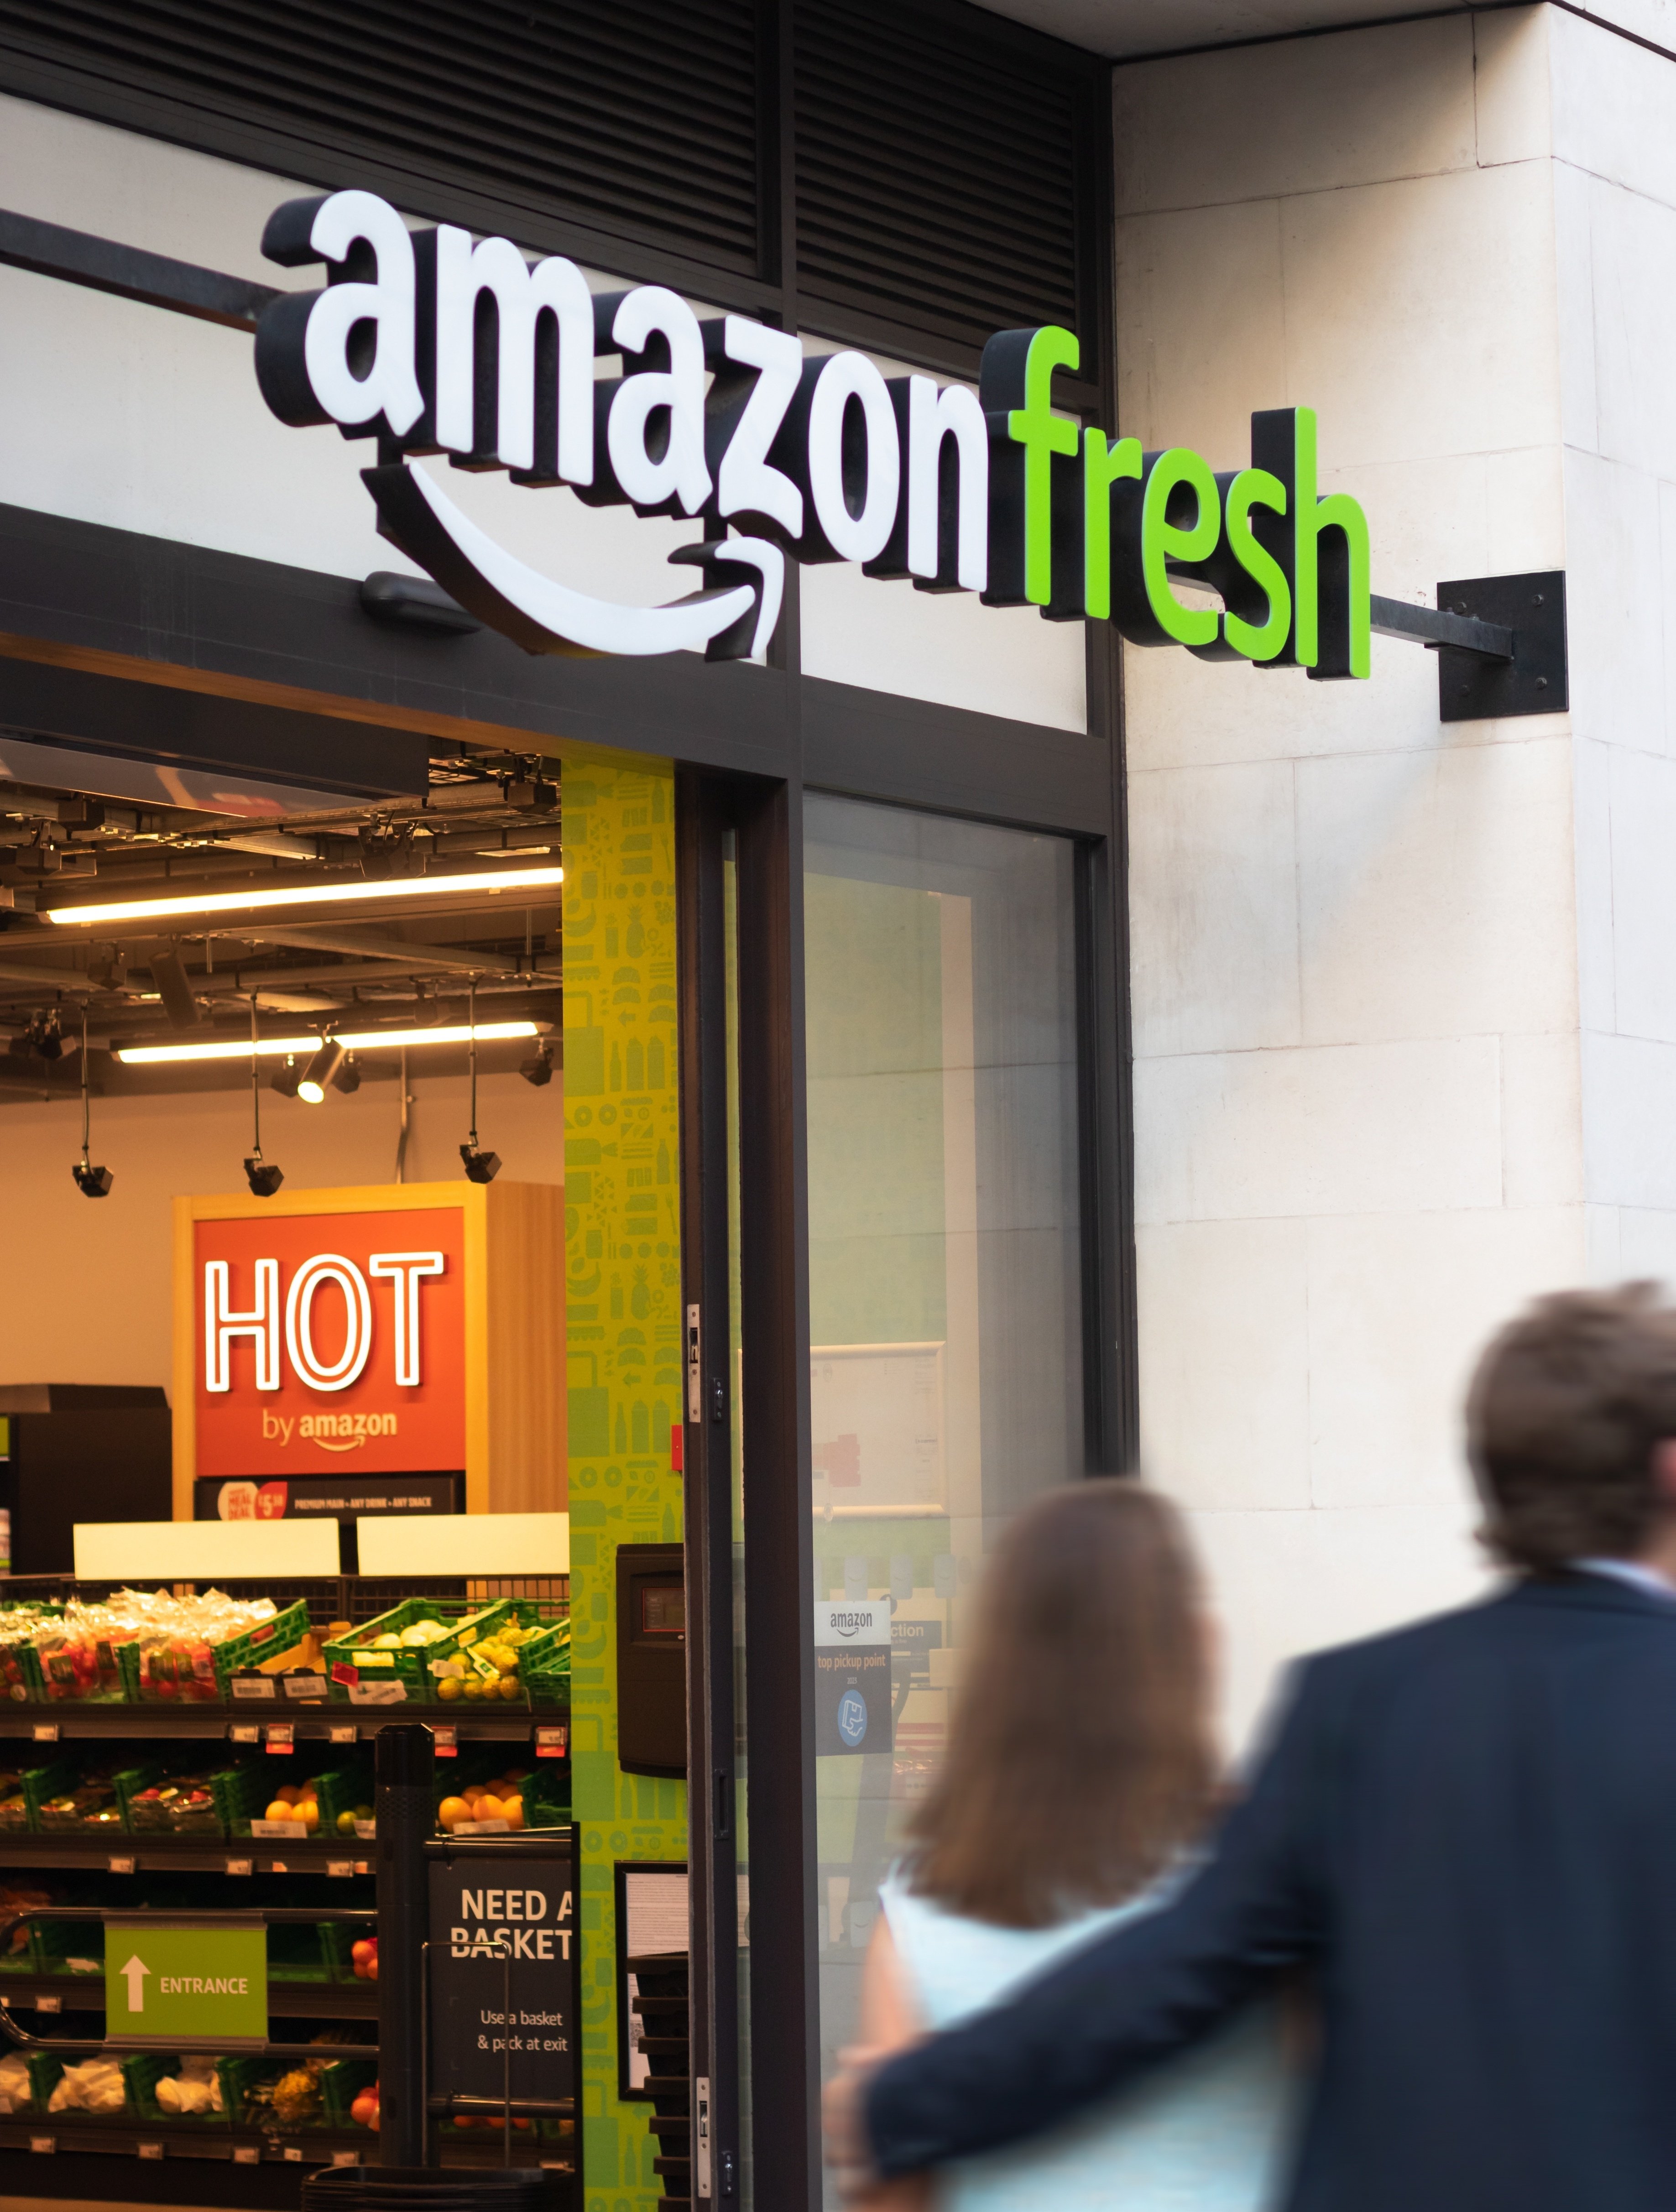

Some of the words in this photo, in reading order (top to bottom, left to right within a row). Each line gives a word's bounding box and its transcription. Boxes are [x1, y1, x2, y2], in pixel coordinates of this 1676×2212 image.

[305, 189, 989, 593] amazon
[1008, 326, 1370, 680] fresh
[205, 1251, 444, 1393] HOT
[262, 1408, 295, 1447] by
[299, 1413, 397, 1438] amazon
[830, 1612, 872, 1628] amazon
[818, 1656, 832, 1671] top
[834, 1654, 861, 1670] pickup
[864, 1653, 886, 1670] point
[462, 1890, 547, 1920] NEED
[451, 1928, 572, 1960] BASKET
[161, 1977, 248, 1994] ENTRANCE
[480, 2010, 505, 2024] Use
[509, 2014, 516, 2024] a
[520, 2011, 563, 2026] basket
[478, 2035, 489, 2050] &
[492, 2035, 522, 2053] pack
[526, 2038, 540, 2050] at
[543, 2037, 568, 2051] exit
